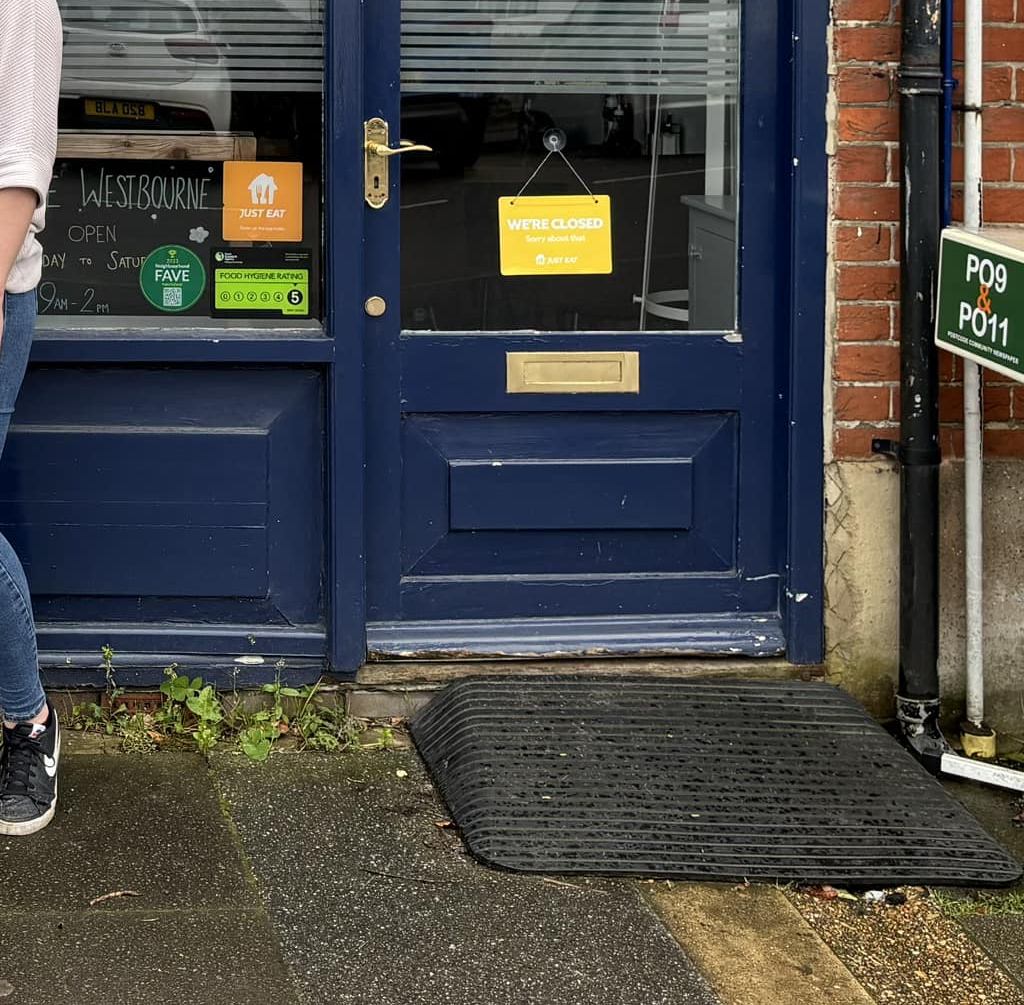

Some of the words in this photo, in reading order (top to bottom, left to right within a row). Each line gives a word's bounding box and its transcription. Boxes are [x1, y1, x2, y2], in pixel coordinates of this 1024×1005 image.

[80, 167, 211, 210] WESTBOURNE
[239, 208, 265, 219] JUST
[266, 208, 287, 219] EAT
[507, 218, 549, 231] WE'RE
[551, 217, 604, 230] CLOSED
[68, 224, 117, 243] OPEN
[525, 235, 546, 244] Sorry
[547, 235, 569, 243] about
[154, 269, 191, 282] FAVE
[219, 272, 243, 280] FOOD
[277, 272, 304, 281] RATING
[966, 253, 1008, 293] PO9
[290, 291, 300, 304] 5
[977, 284, 992, 314] &
[959, 301, 1009, 347] PO11
